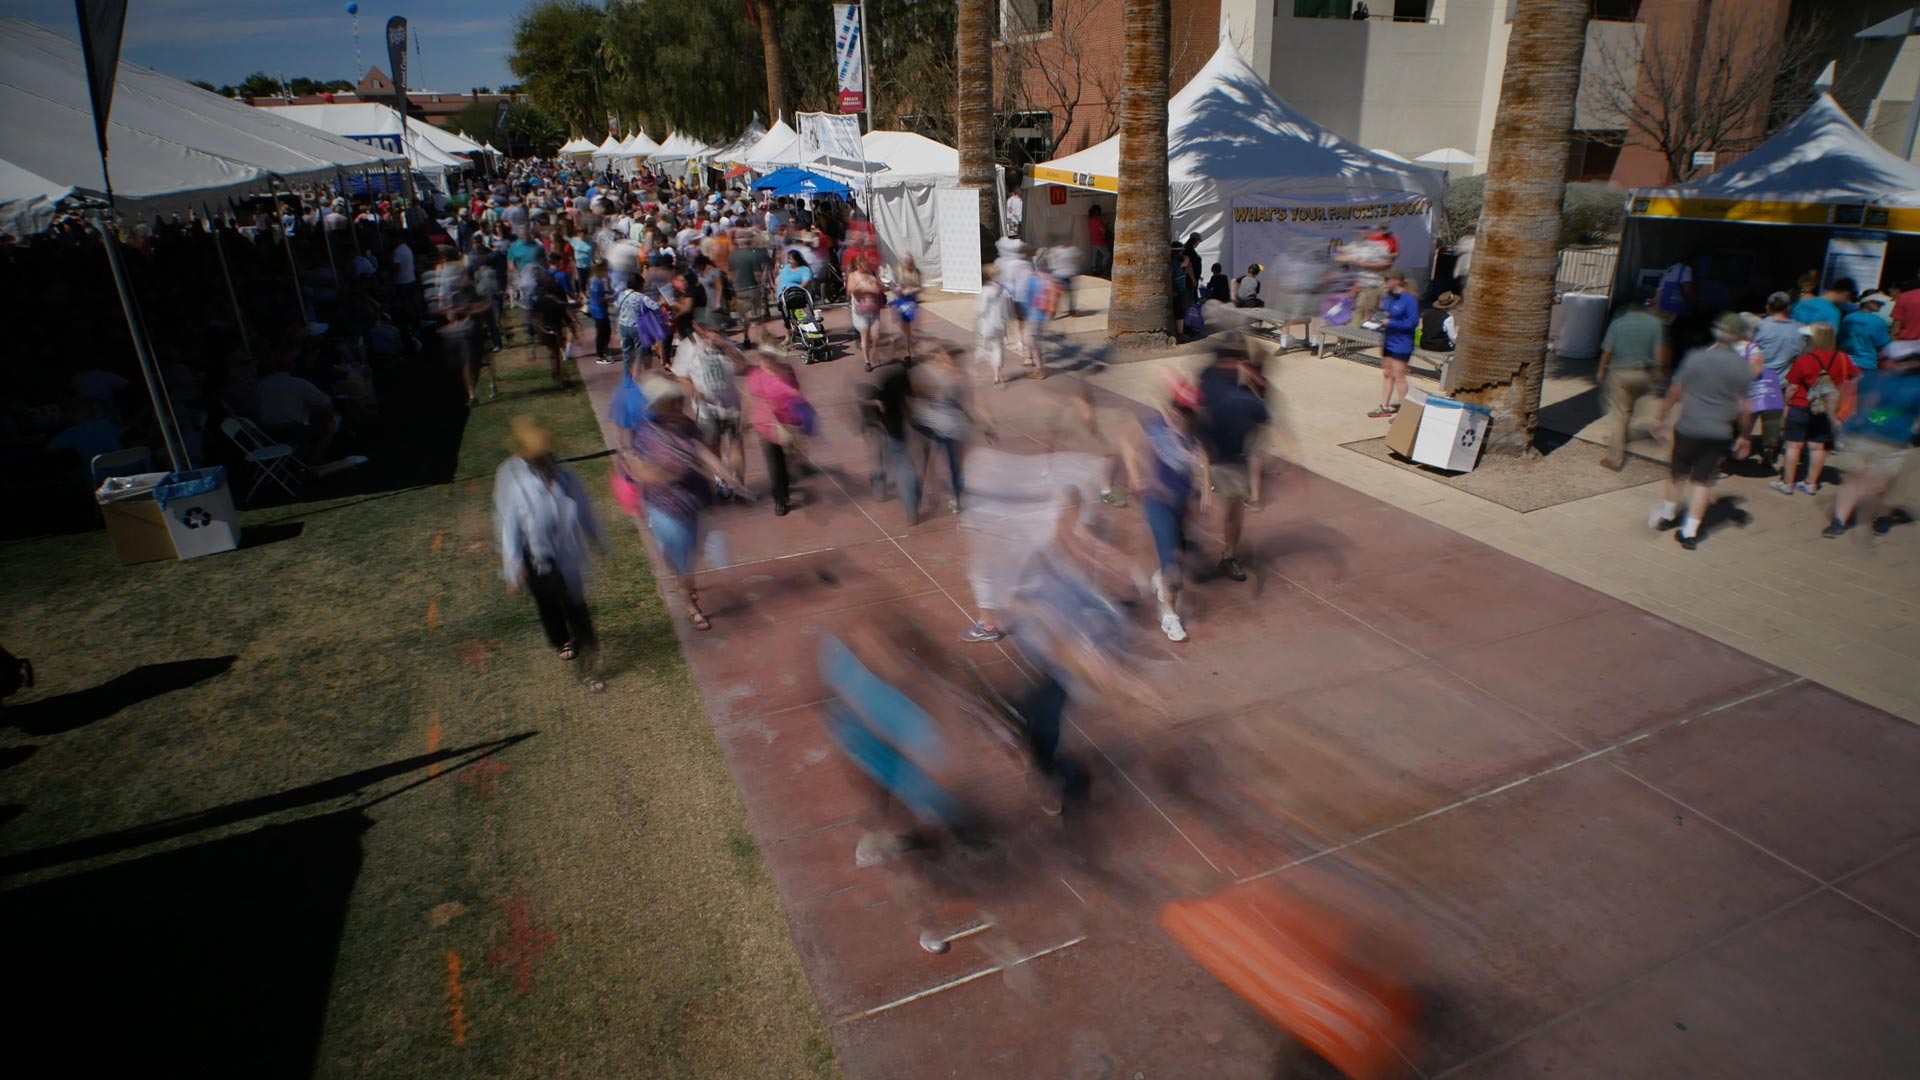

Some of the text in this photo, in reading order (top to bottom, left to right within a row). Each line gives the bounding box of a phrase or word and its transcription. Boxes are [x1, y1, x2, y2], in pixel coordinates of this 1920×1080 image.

[1233, 206, 1287, 223] WHAT'S
[1291, 207, 1327, 221] YOUR
[1328, 204, 1388, 220] FAVORITE
